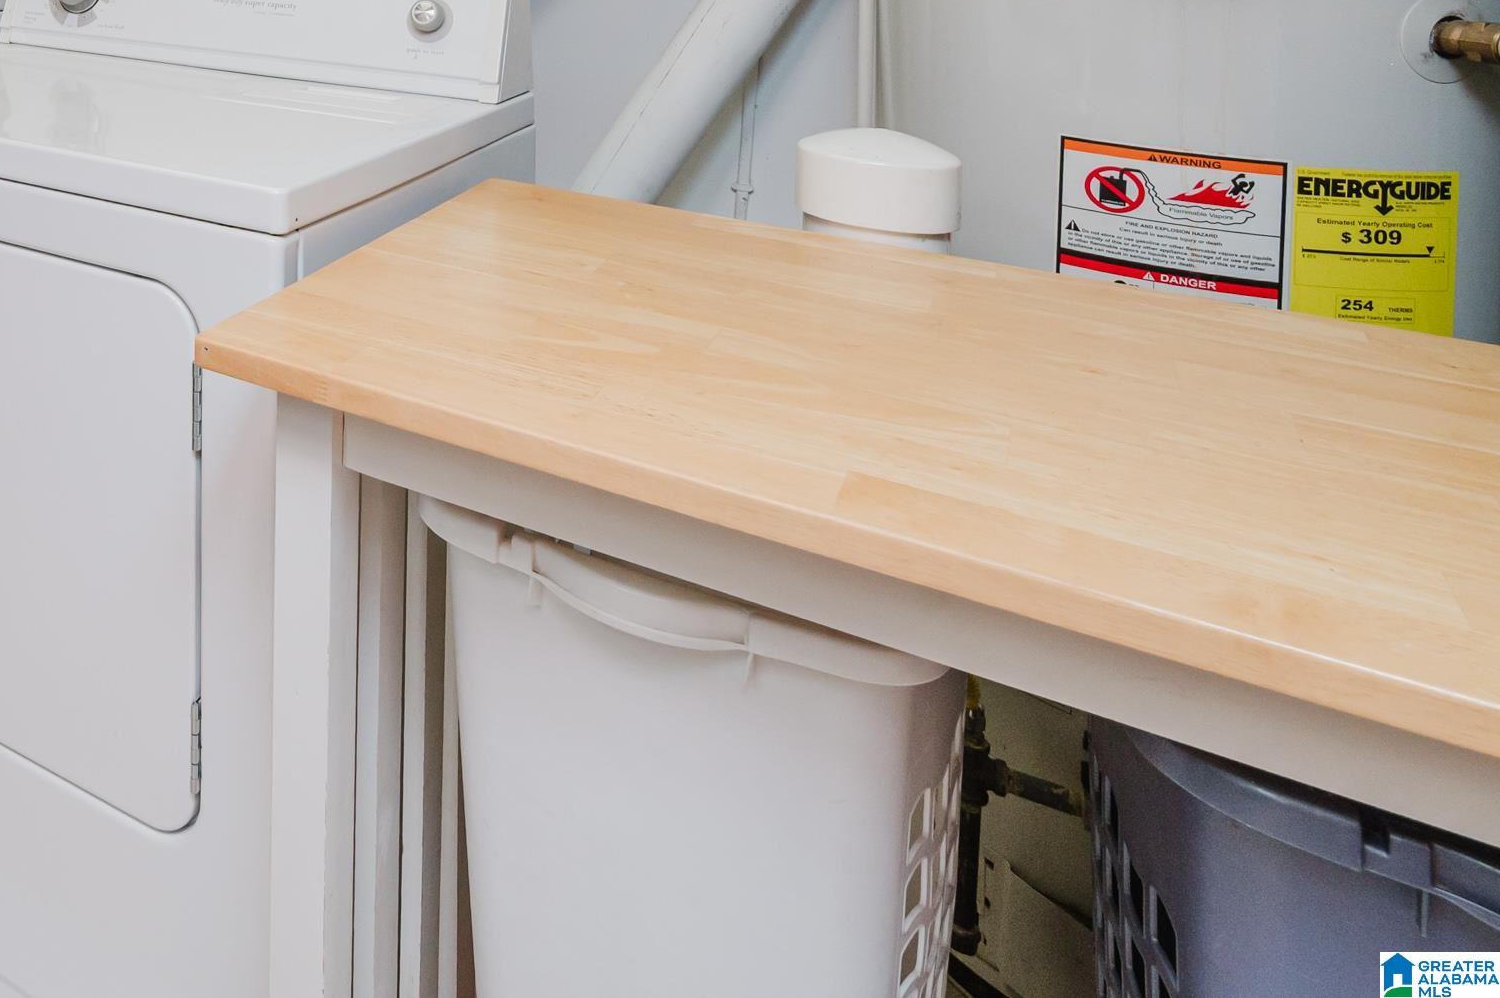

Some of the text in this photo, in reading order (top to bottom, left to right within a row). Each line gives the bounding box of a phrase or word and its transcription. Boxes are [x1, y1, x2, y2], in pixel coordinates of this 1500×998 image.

[1159, 155, 1222, 169] WARNING
[1297, 176, 1452, 202] ENERGYGUIDE
[1209, 212, 1234, 220] Vapors
[1317, 218, 1355, 226] Estimated
[1357, 220, 1380, 228] Yearly
[1382, 221, 1416, 229] Operating
[1155, 226, 1191, 235] EXPLOSION
[1192, 230, 1219, 239] HAZARD
[1341, 229, 1402, 245] $ 309
[1160, 274, 1217, 290] DANGER
[1340, 298, 1374, 312] 254
